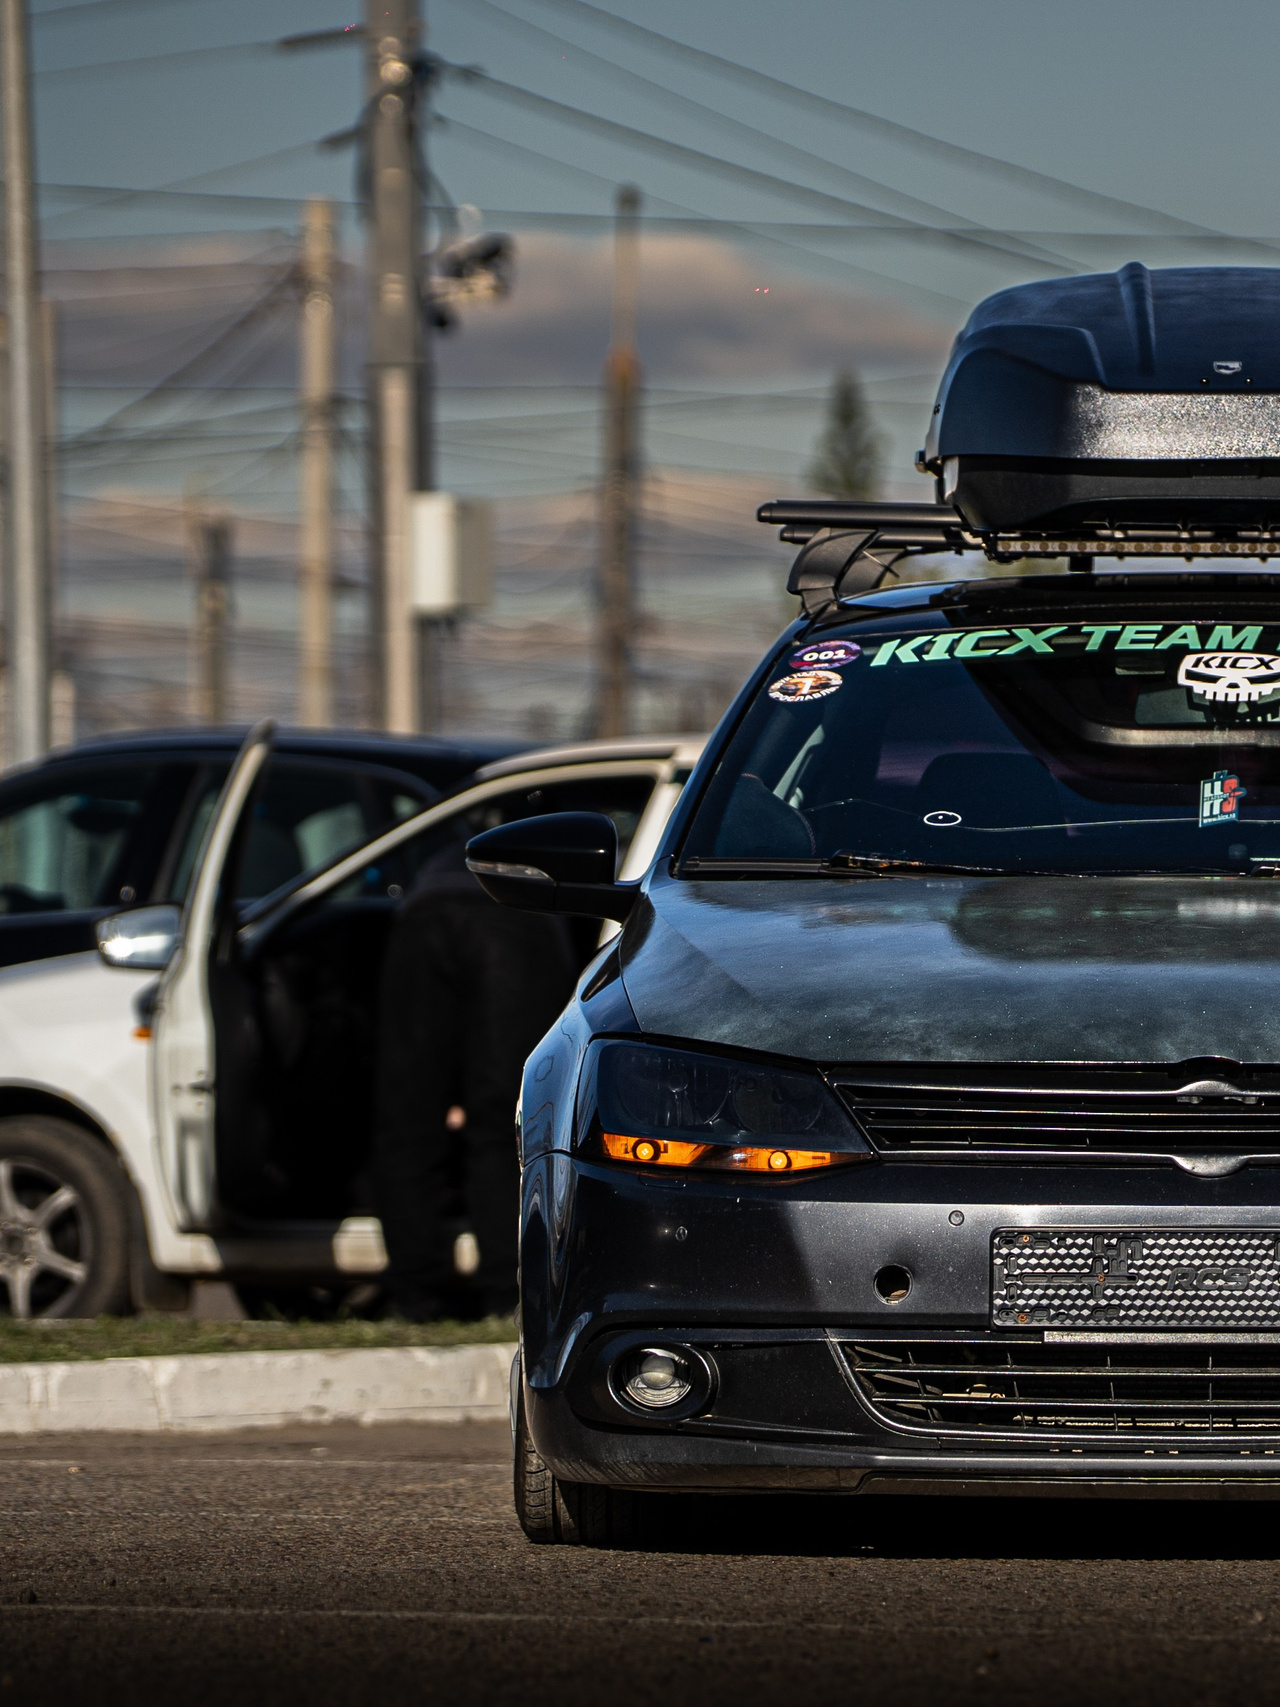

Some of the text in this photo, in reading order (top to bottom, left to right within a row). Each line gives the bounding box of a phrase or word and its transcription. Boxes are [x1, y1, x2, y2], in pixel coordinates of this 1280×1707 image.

[803, 649, 846, 661] 001
[870, 626, 1069, 667] KICX
[1080, 624, 1264, 651] TEAM
[1191, 655, 1280, 671] KICX
[1166, 1267, 1252, 1291] RCS
